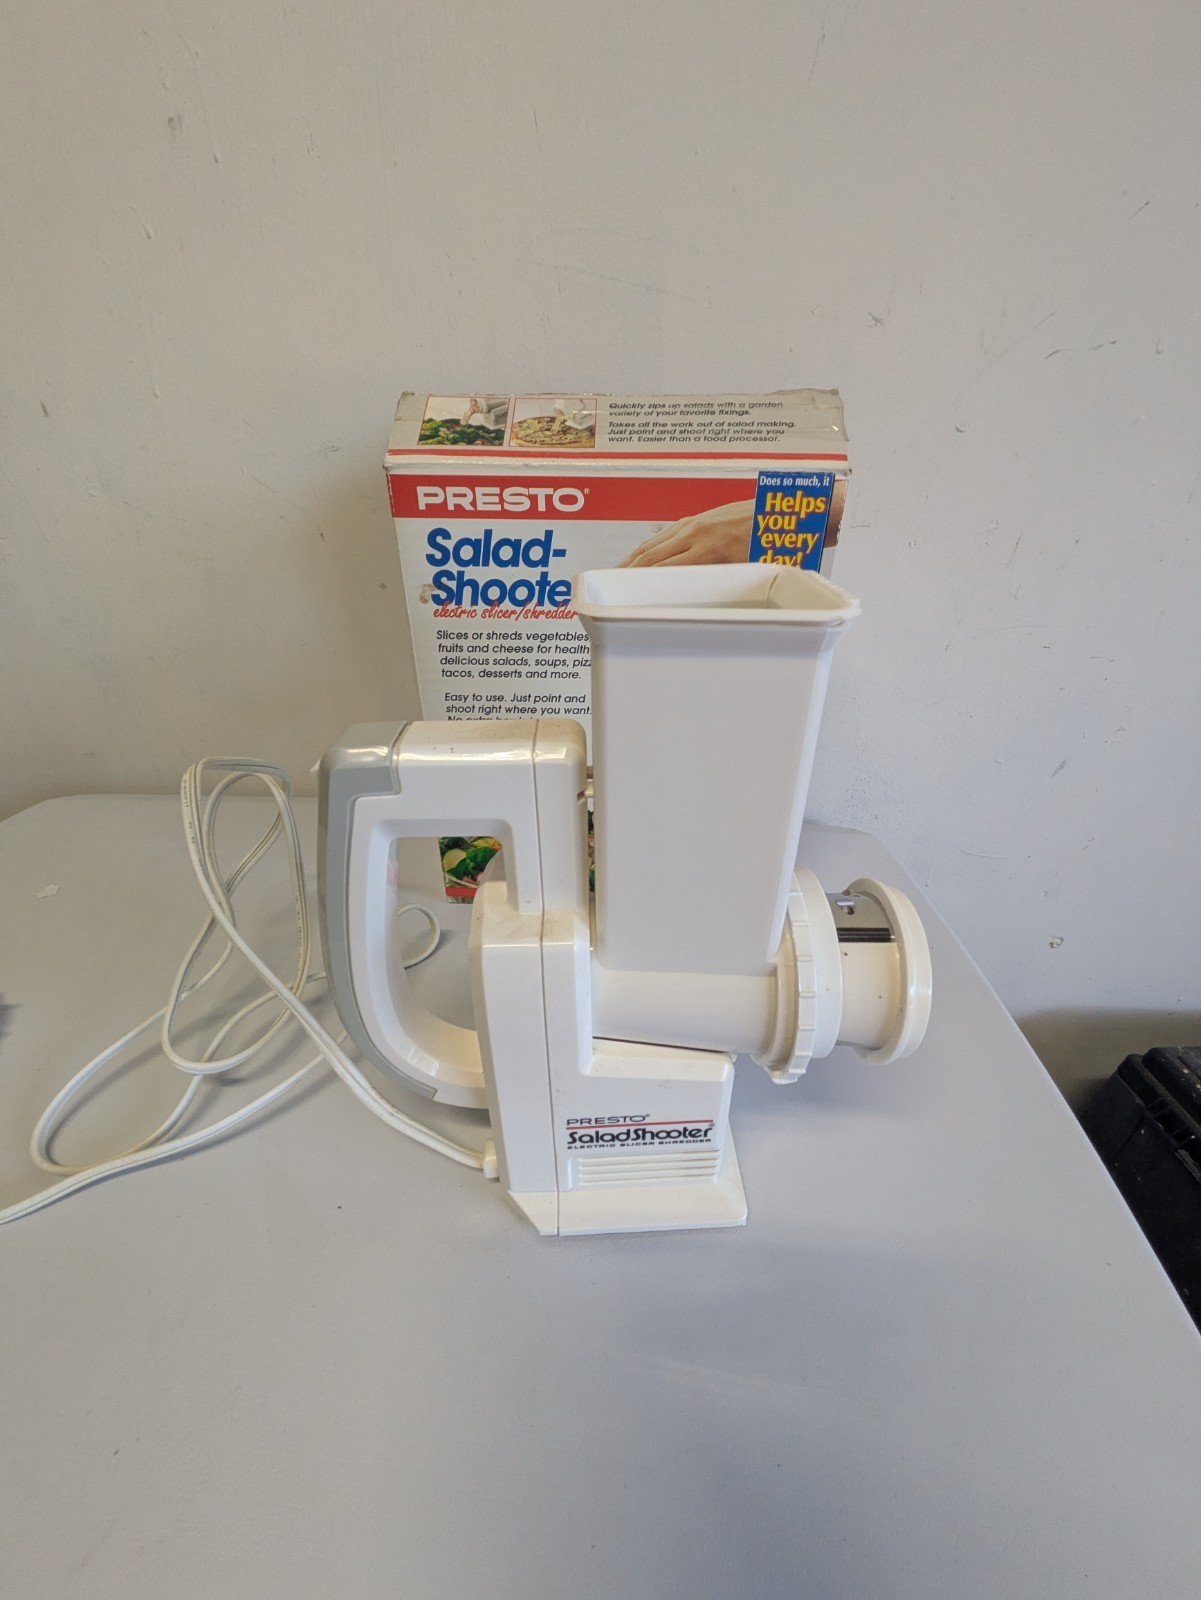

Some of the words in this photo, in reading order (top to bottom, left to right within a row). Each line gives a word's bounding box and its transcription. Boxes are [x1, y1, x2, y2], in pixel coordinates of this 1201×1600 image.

[760, 476, 780, 486] Does
[795, 476, 821, 488] much,
[823, 476, 830, 486] it
[765, 490, 826, 518] Helps
[757, 515, 796, 536] you
[426, 527, 567, 568] Salad-
[761, 532, 819, 554] every
[431, 570, 572, 608] Shoote
[433, 600, 477, 618] electric
[436, 630, 468, 640] Slices
[486, 631, 522, 640] shreds
[438, 643, 464, 653] fruits
[467, 644, 489, 653] and
[492, 644, 534, 653] cheese
[537, 644, 552, 654] for
[555, 644, 590, 654] health
[440, 656, 489, 666] delicious
[492, 657, 531, 667] salads,
[534, 659, 569, 668] soups,
[442, 669, 475, 679] tacos,
[478, 669, 522, 678] desserts
[525, 670, 547, 678] and
[444, 693, 469, 703] Easy
[472, 693, 483, 702] to
[510, 693, 531, 702] Just
[534, 694, 562, 704] point
[564, 694, 586, 703] and
[446, 704, 476, 713] shoot
[478, 704, 502, 716] right
[505, 705, 538, 714] where
[540, 707, 560, 716] you
[564, 706, 592, 715] want.
